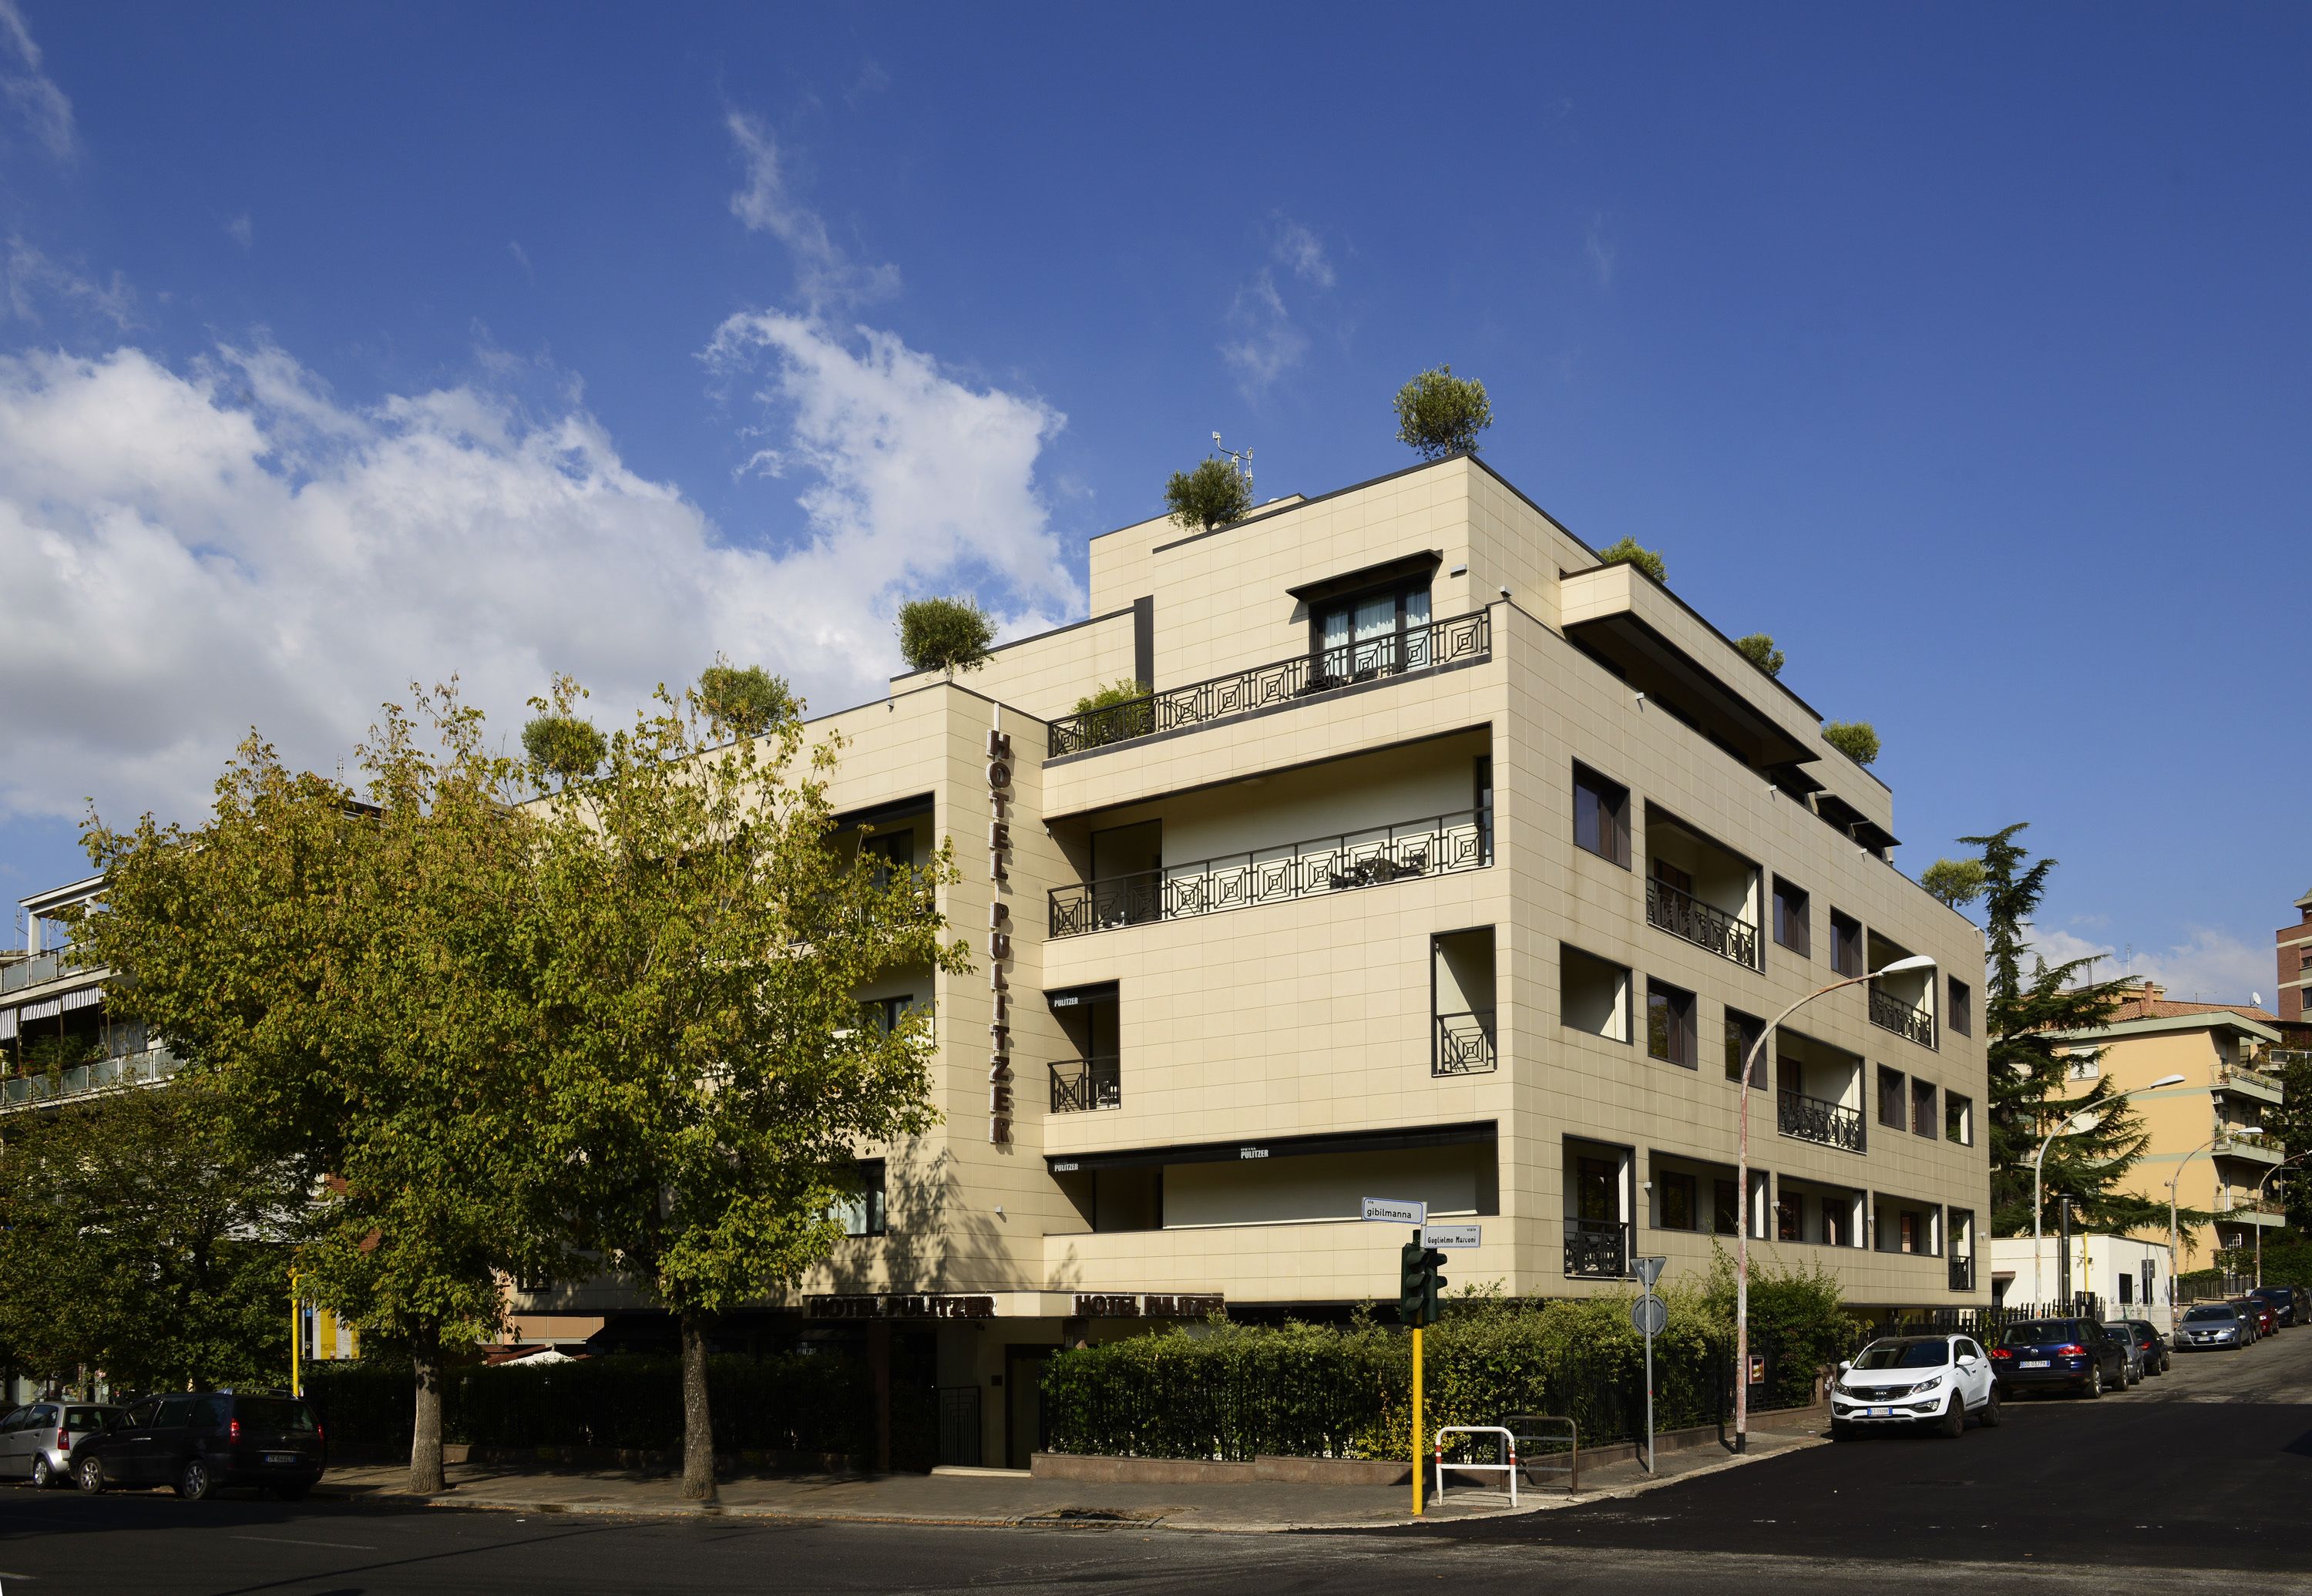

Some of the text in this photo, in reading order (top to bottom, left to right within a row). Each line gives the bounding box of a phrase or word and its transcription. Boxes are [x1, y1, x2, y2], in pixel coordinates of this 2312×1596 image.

[987, 729, 1011, 1144] HOTEL PULITZER
[1054, 997, 1078, 1007] PULITZER
[1240, 1149, 1269, 1159] PULITZER
[1054, 1163, 1078, 1171] PULITZER
[1366, 1208, 1412, 1219] gibilmanna
[1427, 1235, 1477, 1245] Guglielmo Marconi
[809, 1295, 995, 1319] HOTEL PULITZER
[1073, 1295, 1226, 1316] HOTEL PULITZER
